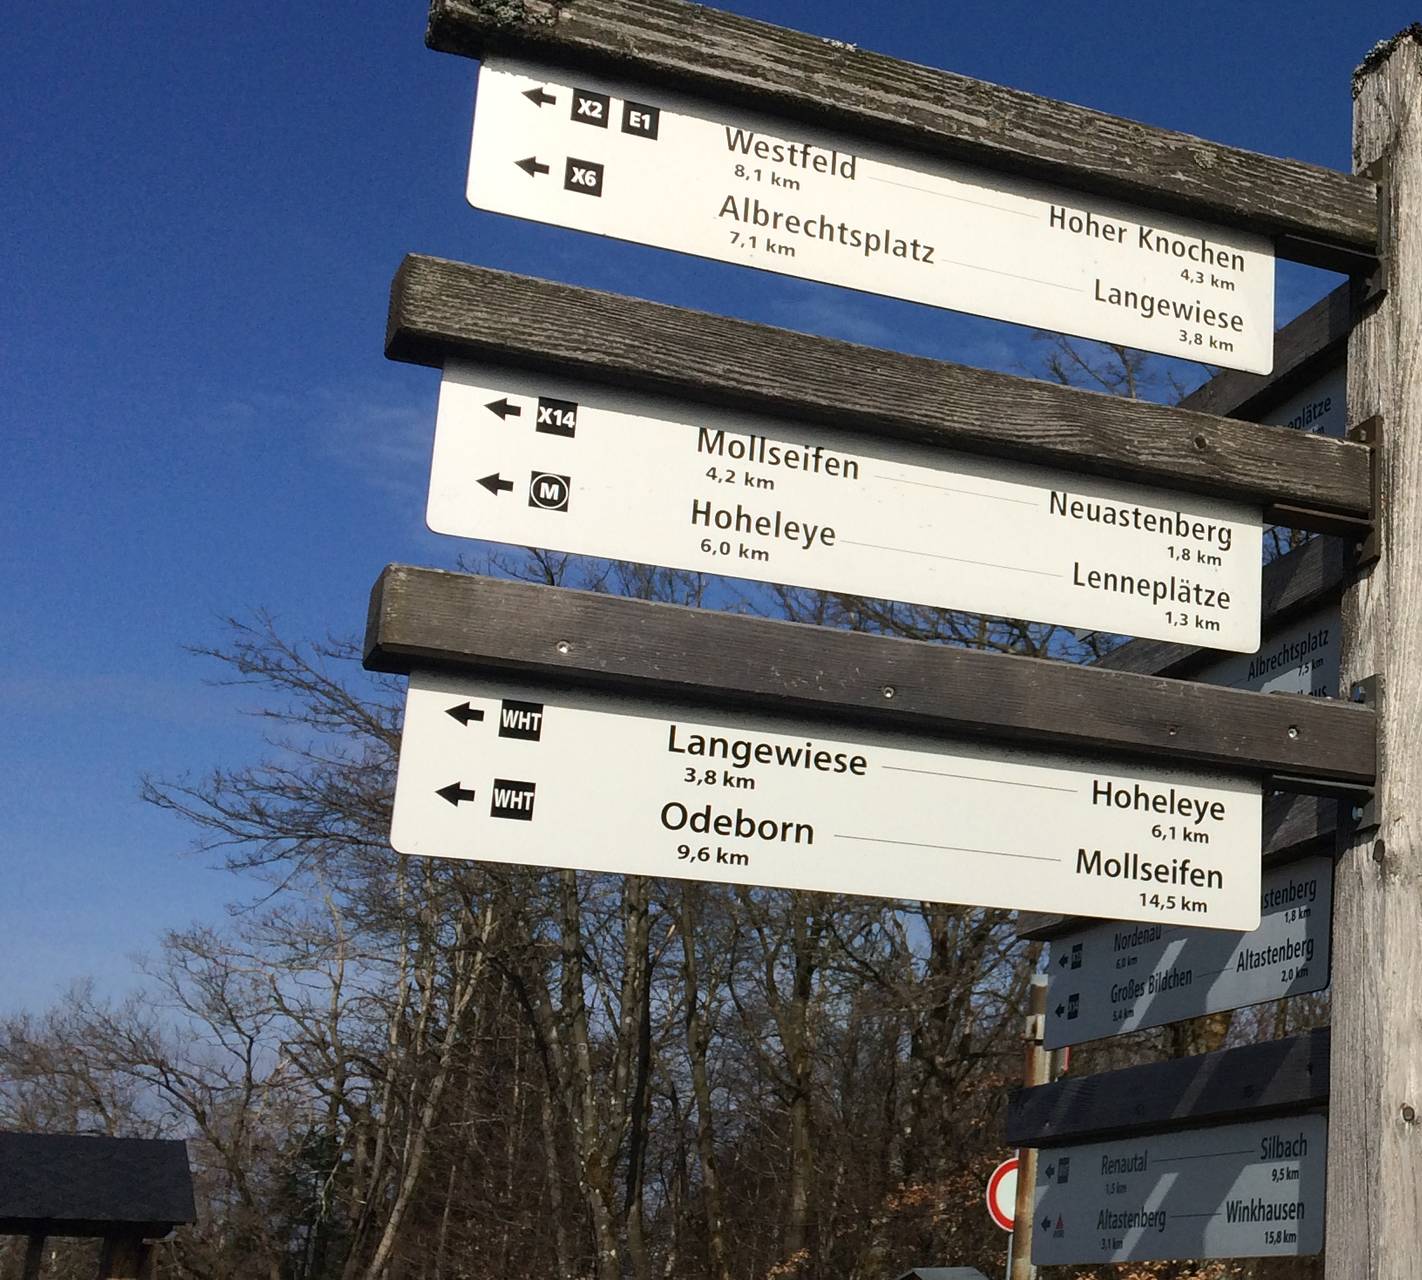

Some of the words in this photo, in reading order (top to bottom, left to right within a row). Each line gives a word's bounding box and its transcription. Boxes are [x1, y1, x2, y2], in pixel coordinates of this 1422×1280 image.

[576, 96, 603, 120] X2
[629, 109, 652, 129] E1
[725, 127, 856, 180] Westfeld
[570, 168, 597, 188] X6
[735, 165, 762, 182] 8,1
[772, 172, 800, 190] km
[719, 195, 934, 264] Albrechtsplatz
[1050, 206, 1127, 243] Hoher
[1139, 226, 1244, 272] Knochen
[730, 231, 756, 248] 7,1
[766, 238, 795, 257] km
[1181, 269, 1204, 285] 4,3
[1211, 274, 1234, 291] km
[1095, 279, 1244, 332] Langewiese
[1179, 330, 1202, 346] 3,8
[1210, 336, 1233, 352] km
[538, 408, 575, 428] X14
[697, 427, 860, 480] Mollseifen
[706, 467, 735, 483] 4,2
[745, 472, 774, 490] km
[540, 484, 558, 500] M
[692, 499, 836, 550] Hoheleye
[1050, 491, 1232, 551] Neuastenberg
[701, 539, 730, 555] 6,0
[739, 543, 769, 561] km
[1168, 546, 1190, 561] 1,8
[1198, 550, 1221, 566] km
[1074, 562, 1230, 609] Lenneplätze
[1166, 611, 1188, 626] 1,3
[1196, 615, 1219, 631] km
[1248, 630, 1328, 681] Albrechtsplatz
[1298, 663, 1309, 676] 7,5
[1312, 658, 1323, 670] km
[502, 710, 541, 731] WHT
[669, 725, 867, 775] Langewiese
[684, 768, 716, 785] 3,8
[723, 771, 755, 789] km
[494, 789, 534, 810] WHT
[1093, 780, 1225, 825] Hoheleye
[661, 802, 813, 844] Odeborn
[1152, 825, 1175, 840] 6,1
[1183, 827, 1208, 843] km
[678, 845, 710, 863] 9,6
[717, 847, 748, 865] km
[1077, 849, 1222, 889] Mollseifen
[1140, 893, 1175, 910] 14,5
[1182, 896, 1207, 913] km
[1284, 910, 1296, 923] 1,8
[1298, 907, 1311, 920] km
[1114, 925, 1162, 952] Nordenau
[1236, 937, 1314, 973] Altastenberg
[1111, 975, 1145, 1003] Großes
[1148, 968, 1192, 995] Bildchen
[1281, 969, 1294, 983] 2,0
[1295, 966, 1309, 980] km
[1260, 1133, 1307, 1159] Silbach
[1101, 1150, 1147, 1175] Renautal
[1272, 1168, 1285, 1182] 9,5
[1286, 1166, 1299, 1180] km
[1097, 1204, 1166, 1233] Altastenberg
[1226, 1199, 1304, 1224] Winkhausen
[1264, 1231, 1281, 1245] 15,8
[1283, 1230, 1296, 1243] km
